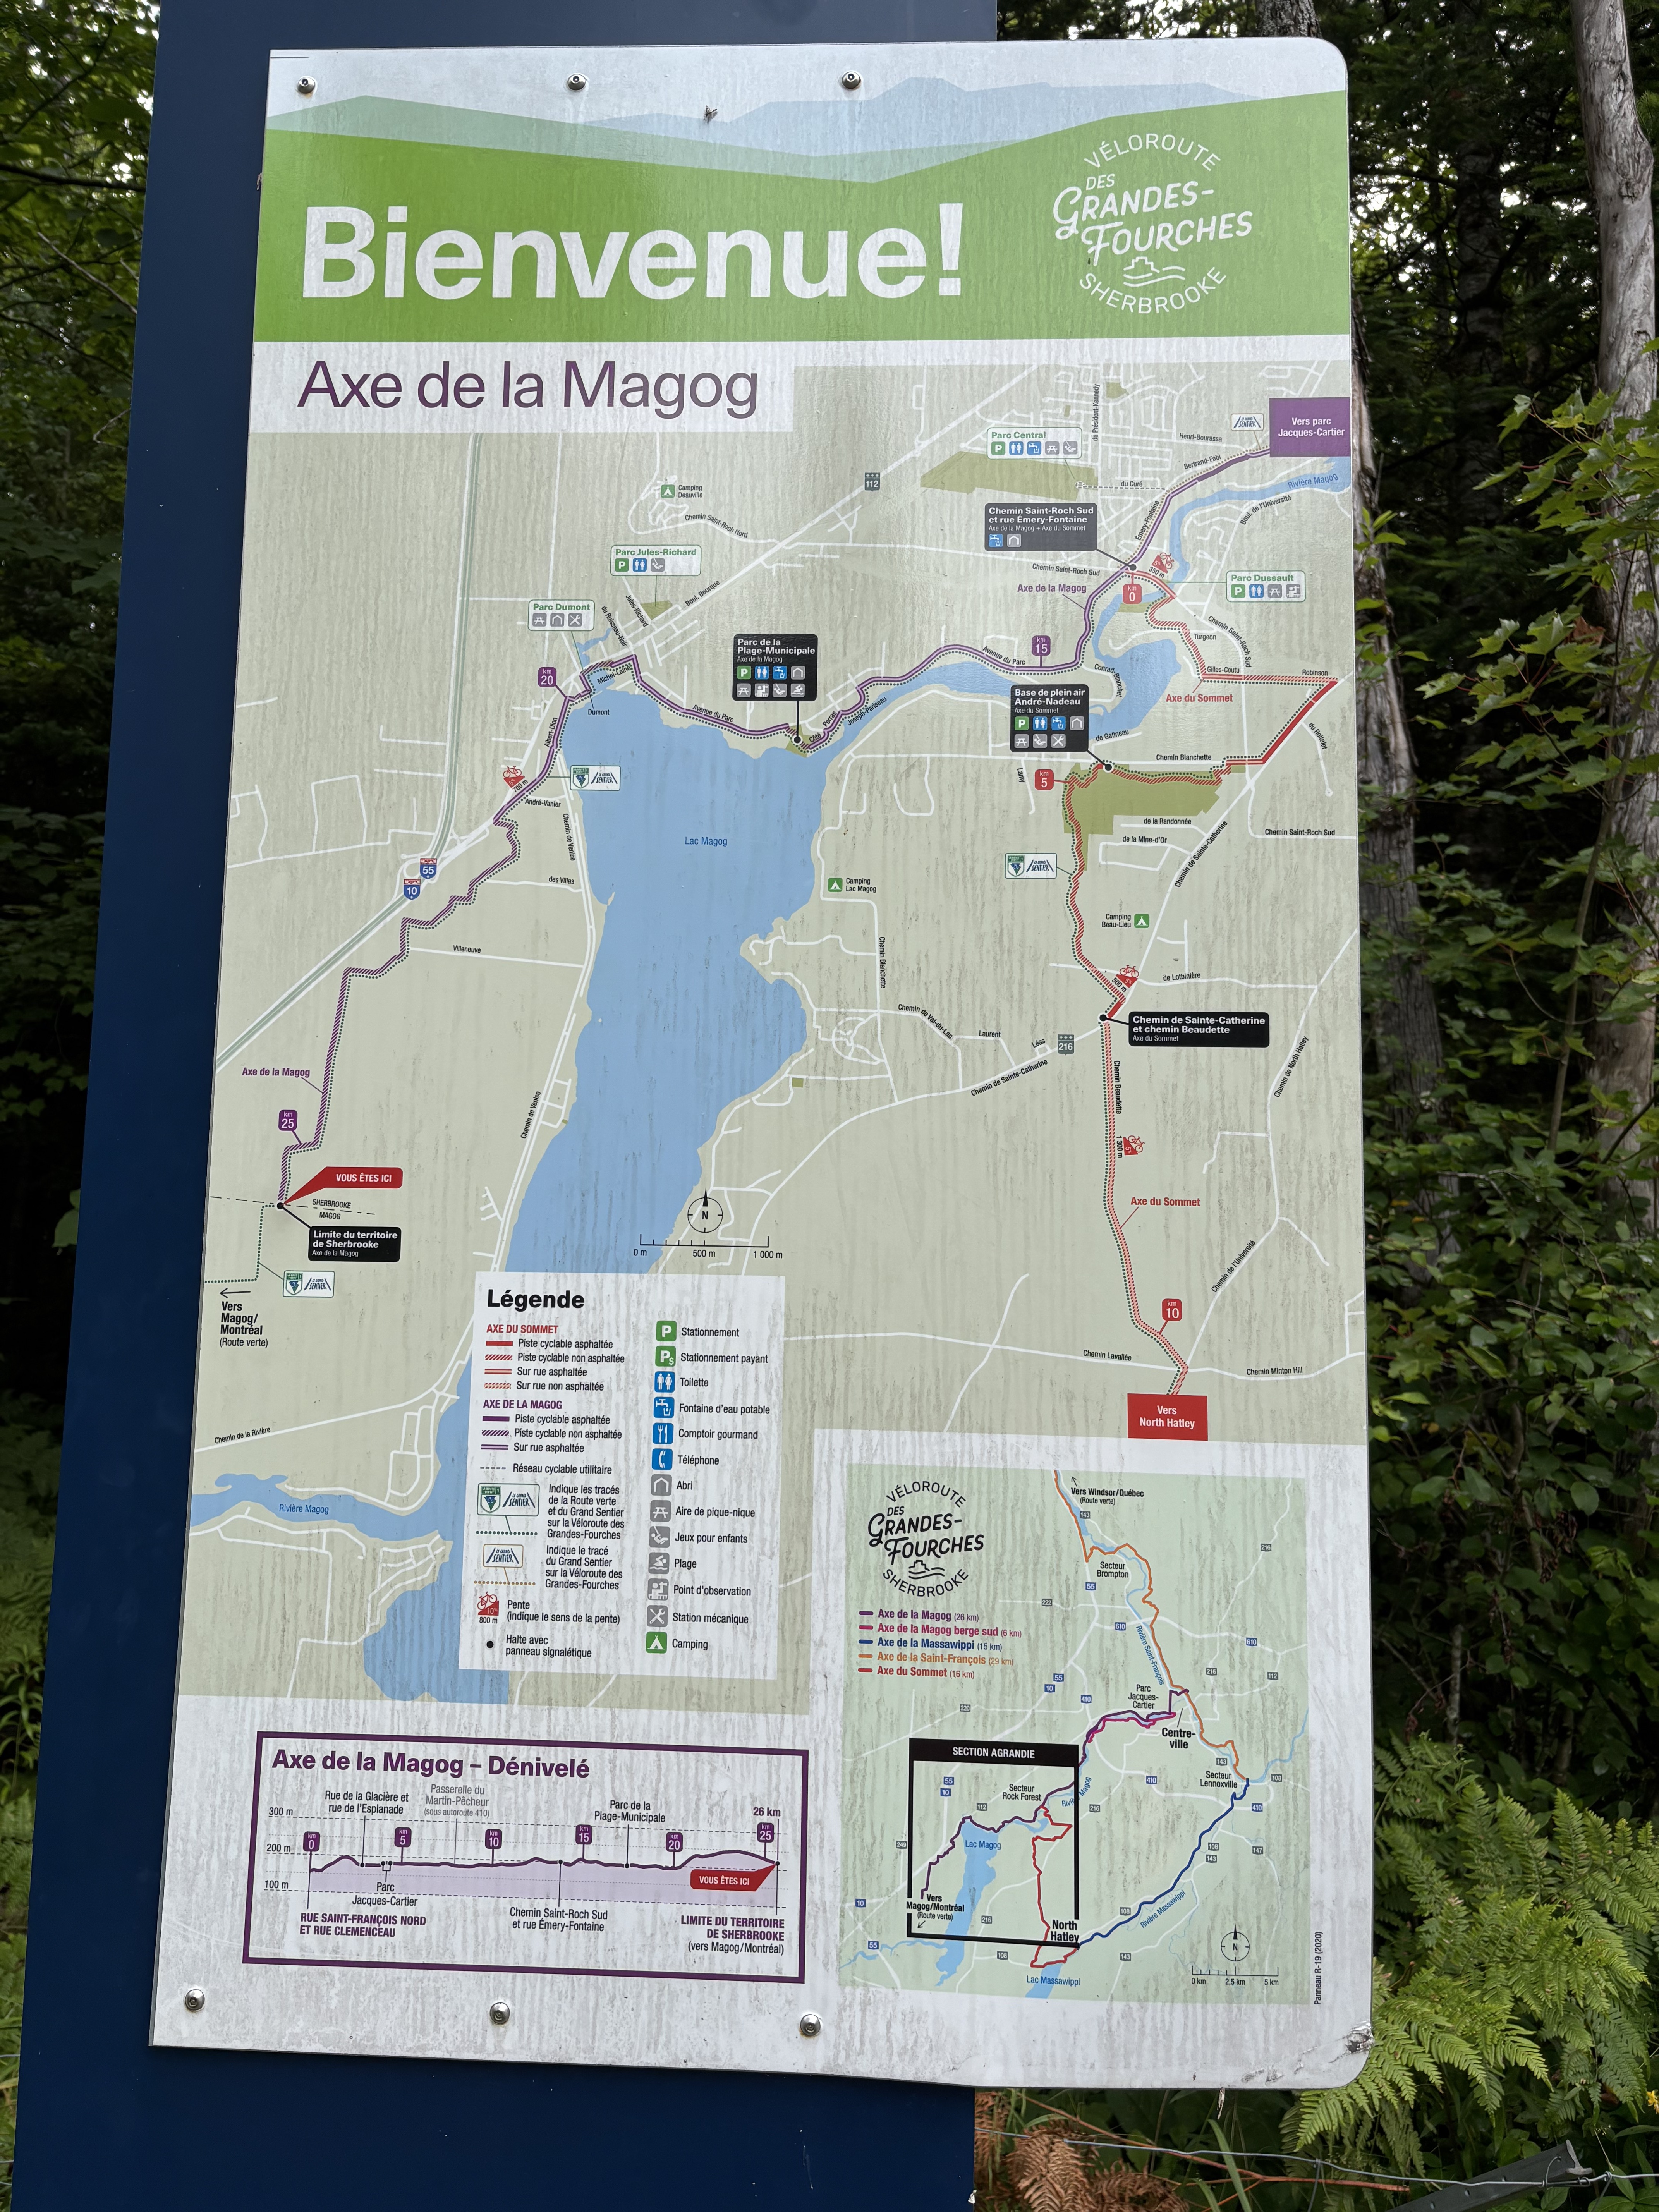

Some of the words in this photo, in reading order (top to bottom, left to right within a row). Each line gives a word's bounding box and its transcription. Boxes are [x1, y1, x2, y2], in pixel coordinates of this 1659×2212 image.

[1084, 132, 1221, 172] VÉLOROUTE
[1086, 173, 1115, 190] DES
[1053, 181, 1214, 240] GRANDES-
[1081, 211, 1254, 266] FOURCHES
[302, 203, 963, 300] Bienvenue!
[1079, 266, 1227, 314] SHERBROOKE
[298, 361, 402, 407] Axe
[417, 361, 484, 407] de
[503, 361, 543, 407] la
[564, 361, 757, 419] Magog
[1313, 418, 1331, 427] parc
[1179, 433, 1222, 442] Henri-Bourassa
[1278, 427, 1345, 438] Jacques-Cartier
[1183, 455, 1221, 470] Bertrand-Fabi
[1288, 477, 1312, 489] Rivière
[1314, 473, 1339, 486] Magog
[1018, 514, 1087, 524] Émery-Fontaine
[1058, 585, 1086, 593] Magog
[1129, 592, 1135, 601] 0
[738, 647, 815, 655] Plage-Municipale
[1036, 644, 1048, 654] 15
[541, 676, 553, 685] 20
[1051, 689, 1071, 697] plein
[1041, 778, 1047, 787] 5
[685, 837, 699, 847] Lac
[701, 837, 728, 848] Magog
[423, 866, 434, 875] 55
[407, 887, 417, 895] 10
[453, 945, 481, 953] Villeneuve
[1185, 1016, 1265, 1024] Sainte-Catherine
[282, 1119, 294, 1129] 25
[336, 1174, 357, 1182] VOUS
[359, 1171, 378, 1182] ÊTES
[381, 1174, 392, 1182] ICI
[313, 1199, 351, 1209] SHERBROOKE
[344, 1231, 354, 1239] du
[357, 1231, 398, 1239] territoire
[326, 1240, 379, 1249] Sherbrooke
[488, 1289, 584, 1312] Légende
[222, 1302, 242, 1311] Vers
[221, 1313, 258, 1324] Magog/
[1166, 1309, 1179, 1318] 10
[220, 1324, 263, 1334] Montréal
[507, 1325, 518, 1333] DU
[520, 1325, 558, 1333] SOMMET
[682, 1327, 739, 1337] Stationnement
[220, 1338, 245, 1347] (Route
[246, 1338, 268, 1348] verte)
[519, 1339, 538, 1348] Piste
[540, 1340, 572, 1349] cyclable
[575, 1340, 613, 1350] asphaltée
[681, 1353, 738, 1363] Stationnement
[741, 1355, 768, 1365] payant
[680, 1377, 708, 1387] Toilette
[680, 1404, 713, 1413] Fontaine
[741, 1405, 770, 1415] potable
[1157, 1406, 1177, 1415] Vers
[1140, 1418, 1164, 1427] North
[1166, 1418, 1195, 1430] Hatley
[679, 1429, 715, 1440] Comptoir
[717, 1431, 758, 1441] gourmand
[678, 1455, 719, 1466] Téléphone
[677, 1481, 692, 1490] Abri
[1089, 1488, 1144, 1498] Windsor/Québec
[672, 1639, 708, 1650] Camping
[1162, 1728, 1196, 1737] Centre-
[1170, 1740, 1188, 1749] ville
[953, 1747, 988, 1756] SECTION
[991, 1749, 1035, 1759] AGRANDIE
[272, 1749, 316, 1769] Axe
[322, 1751, 350, 1770] de
[357, 1752, 376, 1771] la
[383, 1753, 463, 1778] Magog
[489, 1756, 590, 1778] Dénivelé
[979, 1841, 1001, 1850] Magog
[301, 1913, 319, 1922] RUE
[322, 1914, 397, 1926] SAINT-FRANÇOIS
[400, 1916, 426, 1925] NORD
[681, 1916, 713, 1926] LIMITE
[716, 1917, 728, 1926] DU
[730, 1918, 785, 1928] TERRITOIRE
[1052, 1920, 1077, 1930] North
[300, 1925, 311, 1934] ET
[313, 1926, 332, 1935] RUE
[334, 1927, 396, 1937] CLEMENCEAU
[707, 1929, 720, 1939] DE
[722, 1930, 785, 1941] SHERBROOKE
[1050, 1932, 1079, 1943] Hatley
[1314, 1932, 1323, 1954] (2020)
